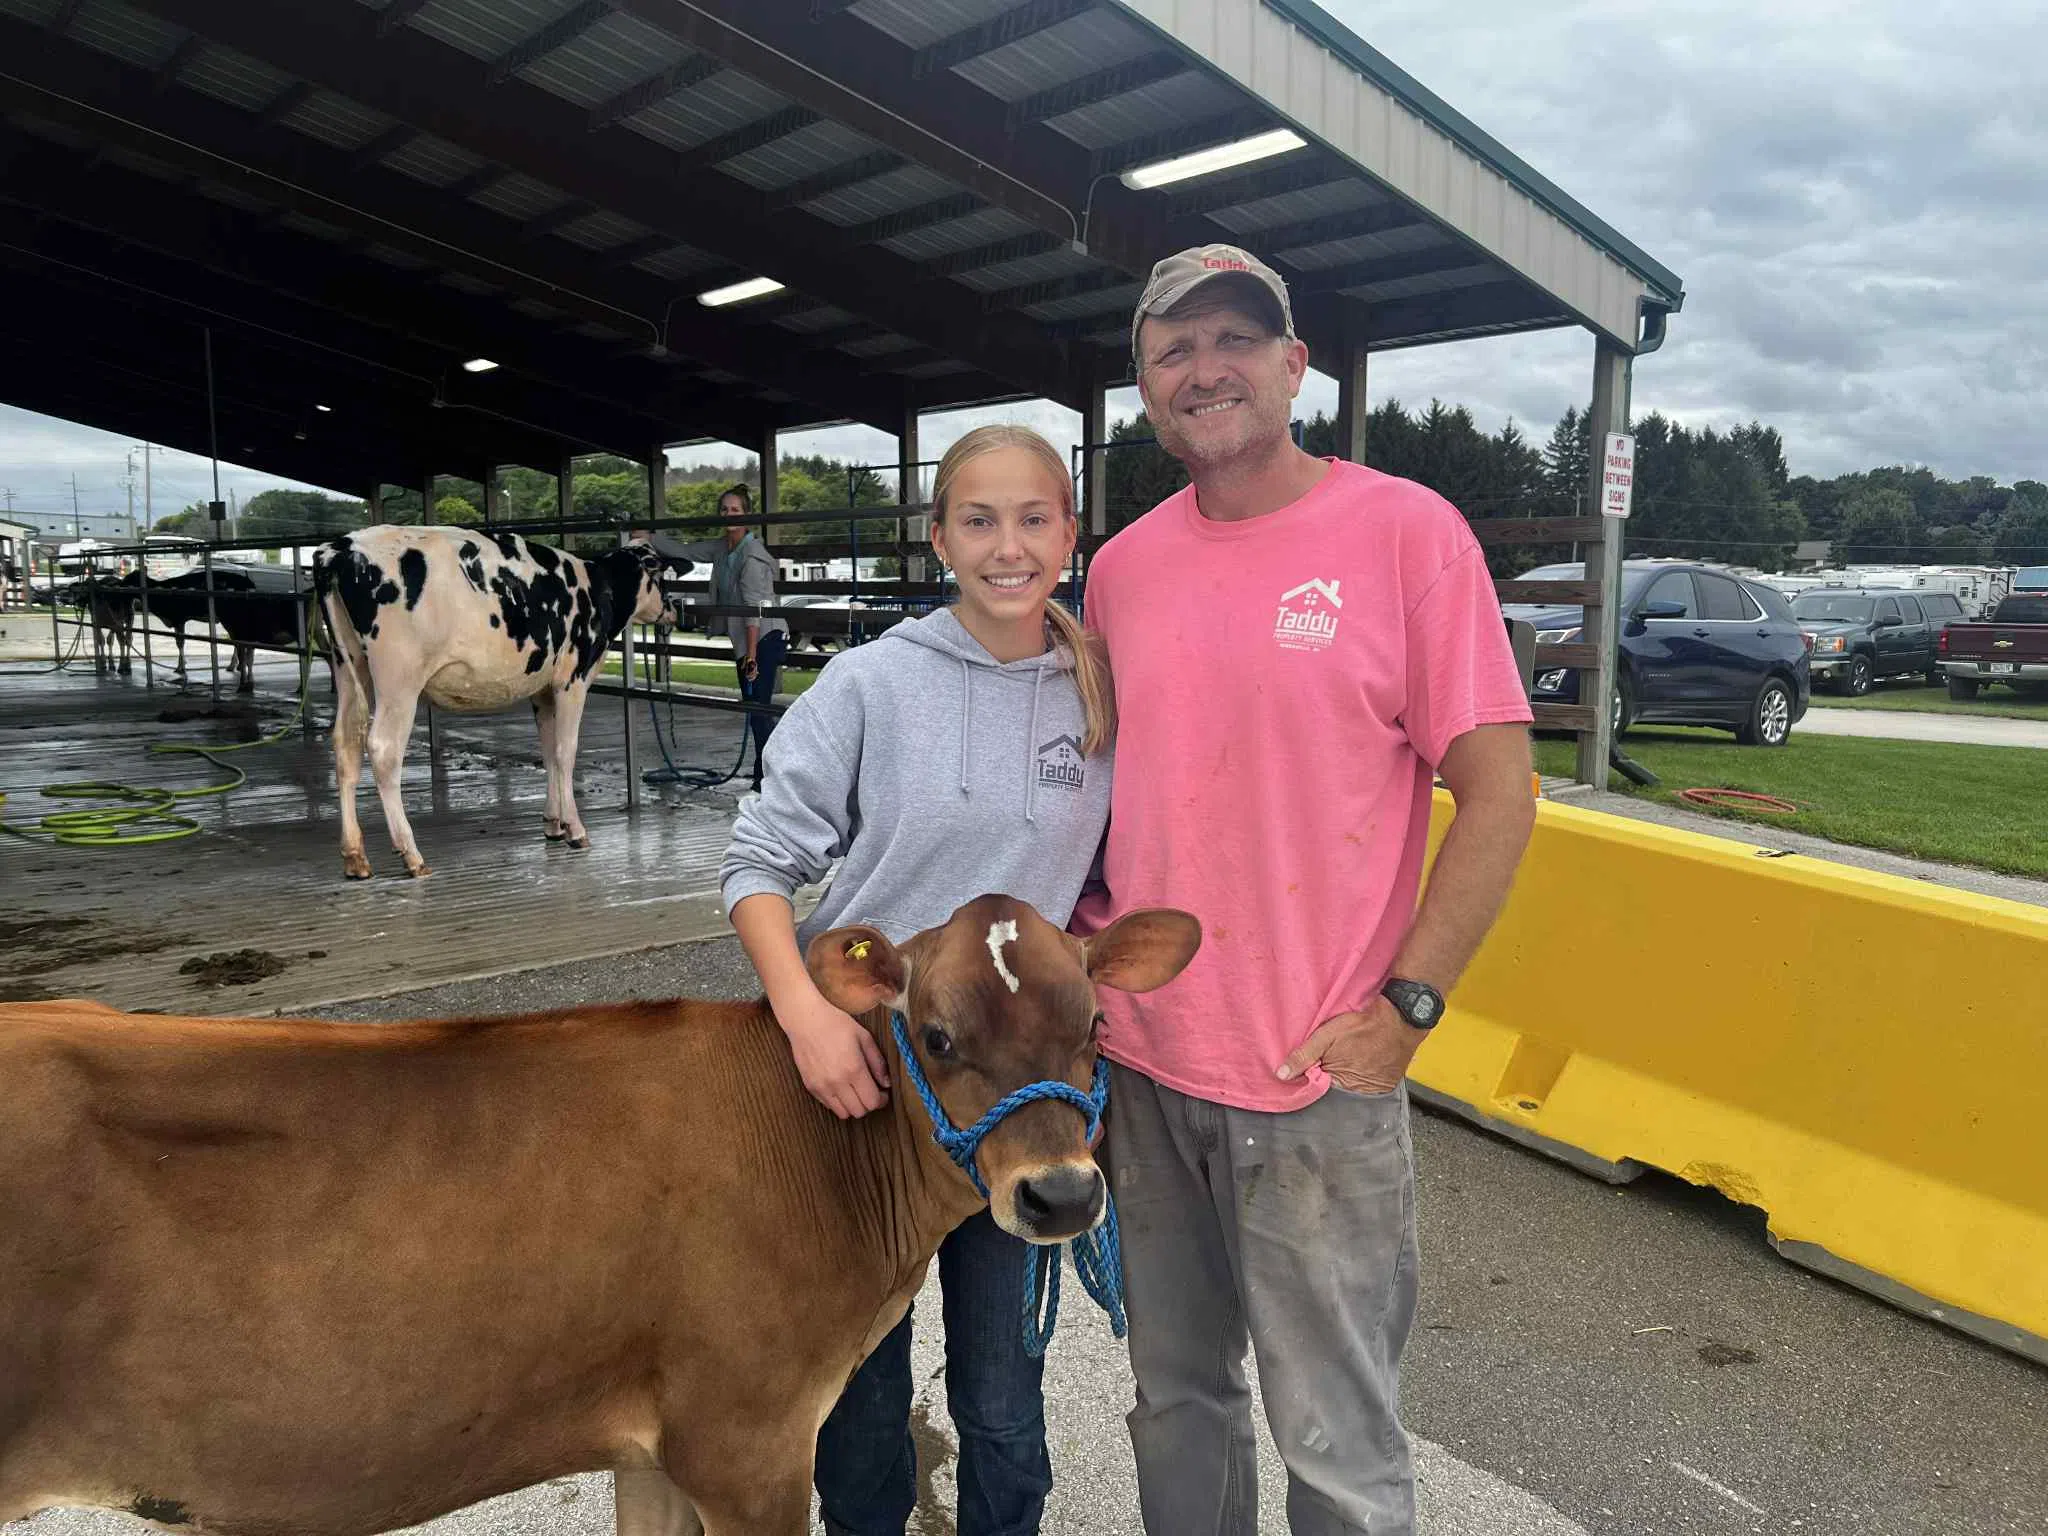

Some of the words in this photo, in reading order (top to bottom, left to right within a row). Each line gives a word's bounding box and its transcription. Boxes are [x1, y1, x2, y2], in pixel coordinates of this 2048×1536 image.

[1616, 439, 1625, 450] NO
[1607, 455, 1631, 469] PARKING
[1605, 472, 1632, 486] BETWEEN
[1609, 489, 1625, 503] SIGNS
[1276, 606, 1338, 638] Taddy
[1038, 758, 1084, 788] Taddy
